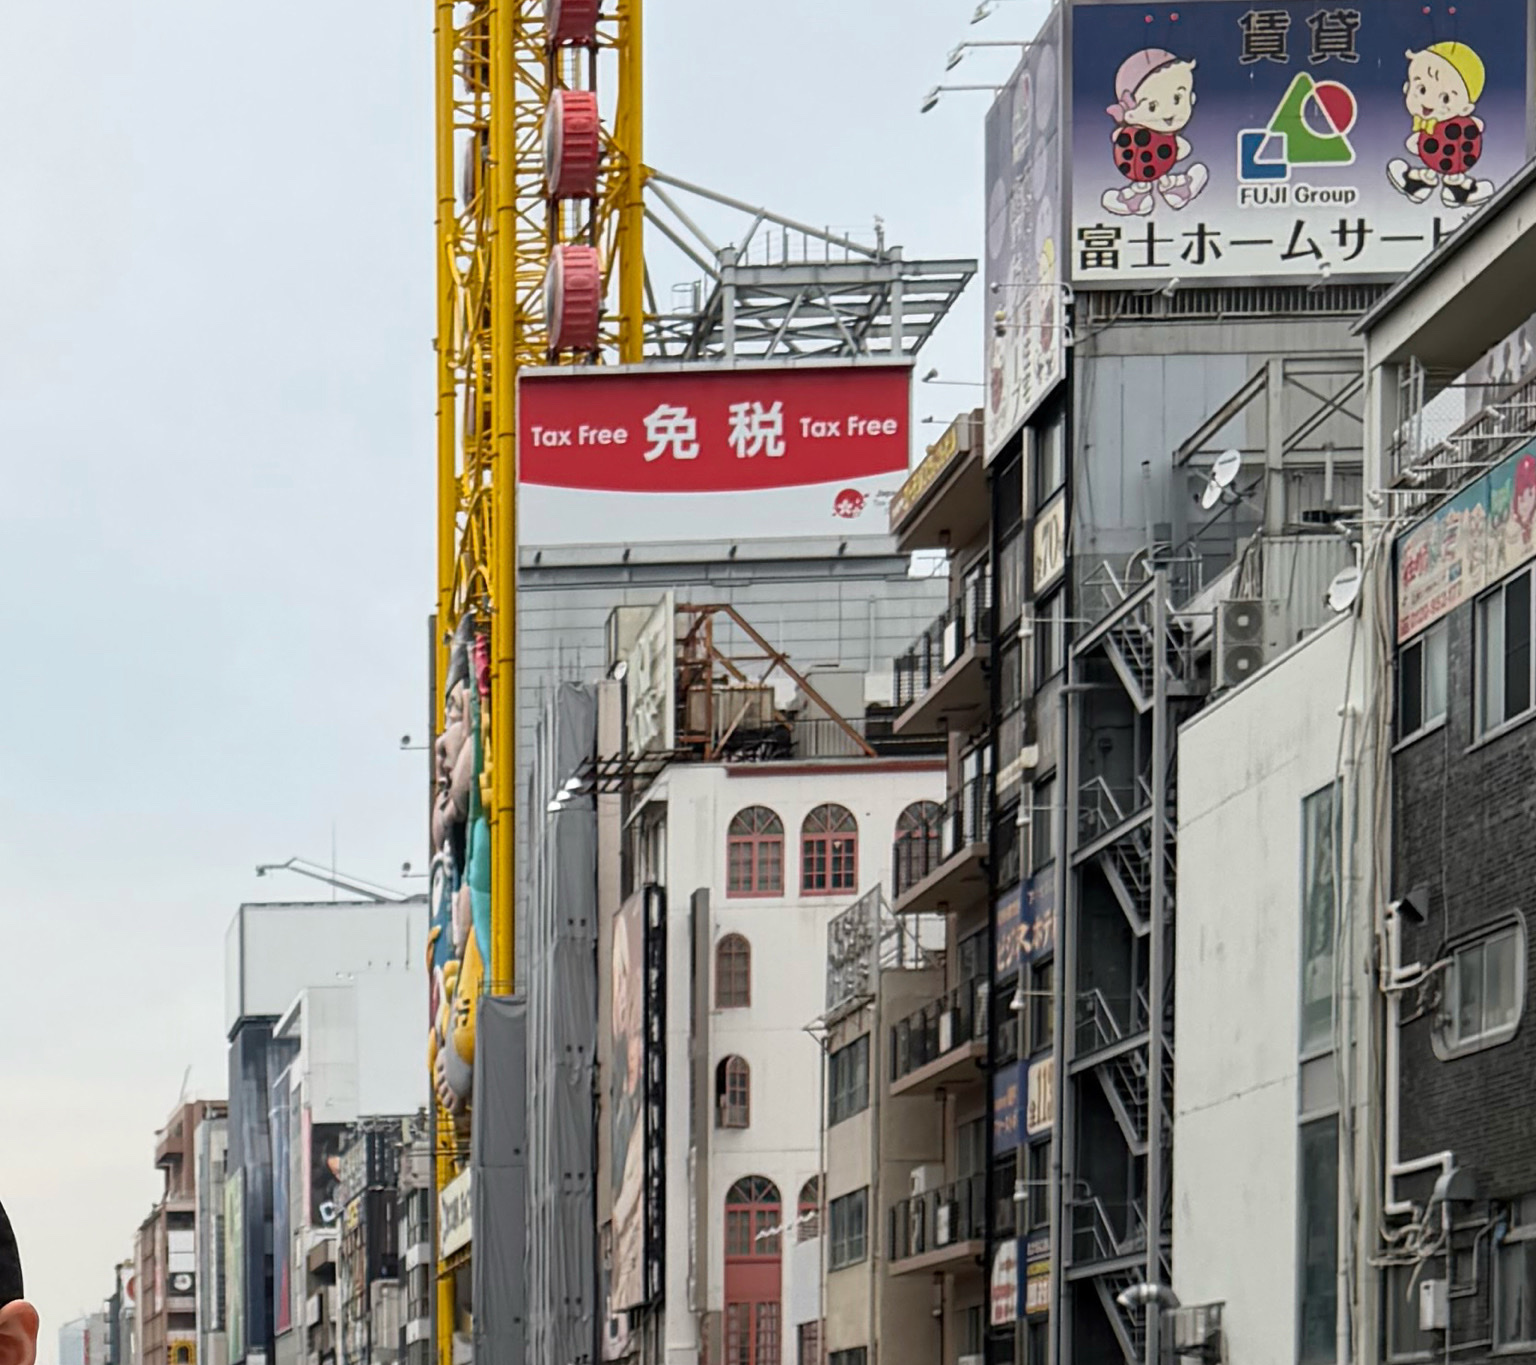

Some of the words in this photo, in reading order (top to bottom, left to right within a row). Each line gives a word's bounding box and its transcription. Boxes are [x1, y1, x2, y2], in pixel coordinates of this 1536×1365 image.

[1238, 9, 1360, 64] 賃貸
[1240, 187, 1287, 205] FUJI
[1295, 186, 1356, 205] Group
[531, 426, 571, 447] Tax
[579, 425, 628, 446] Free
[643, 400, 785, 462] 免税
[800, 417, 840, 438] Tax
[847, 416, 897, 437] Free
